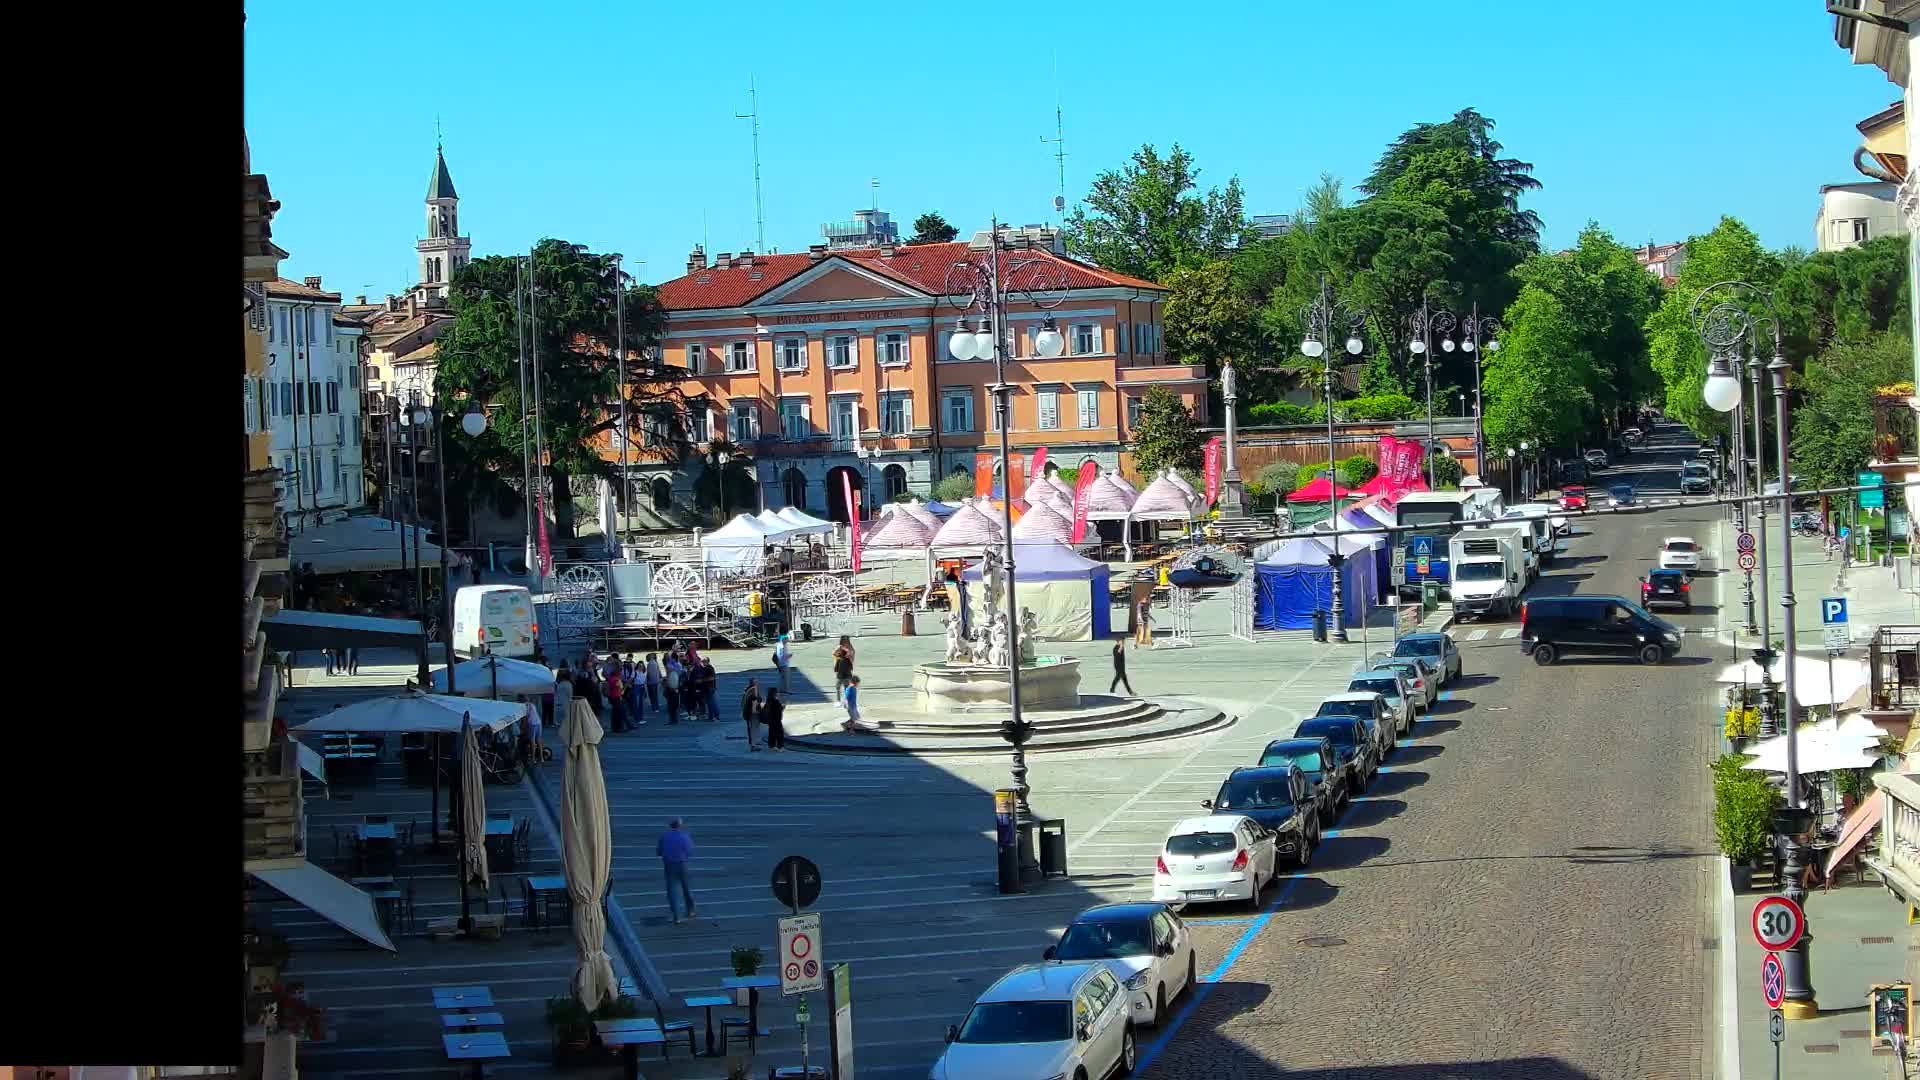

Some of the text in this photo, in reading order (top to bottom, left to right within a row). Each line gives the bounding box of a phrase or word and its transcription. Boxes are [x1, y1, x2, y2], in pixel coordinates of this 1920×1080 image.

[1743, 557, 1752, 566] 20
[1827, 601, 1842, 621] P
[1762, 910, 1791, 936] 30
